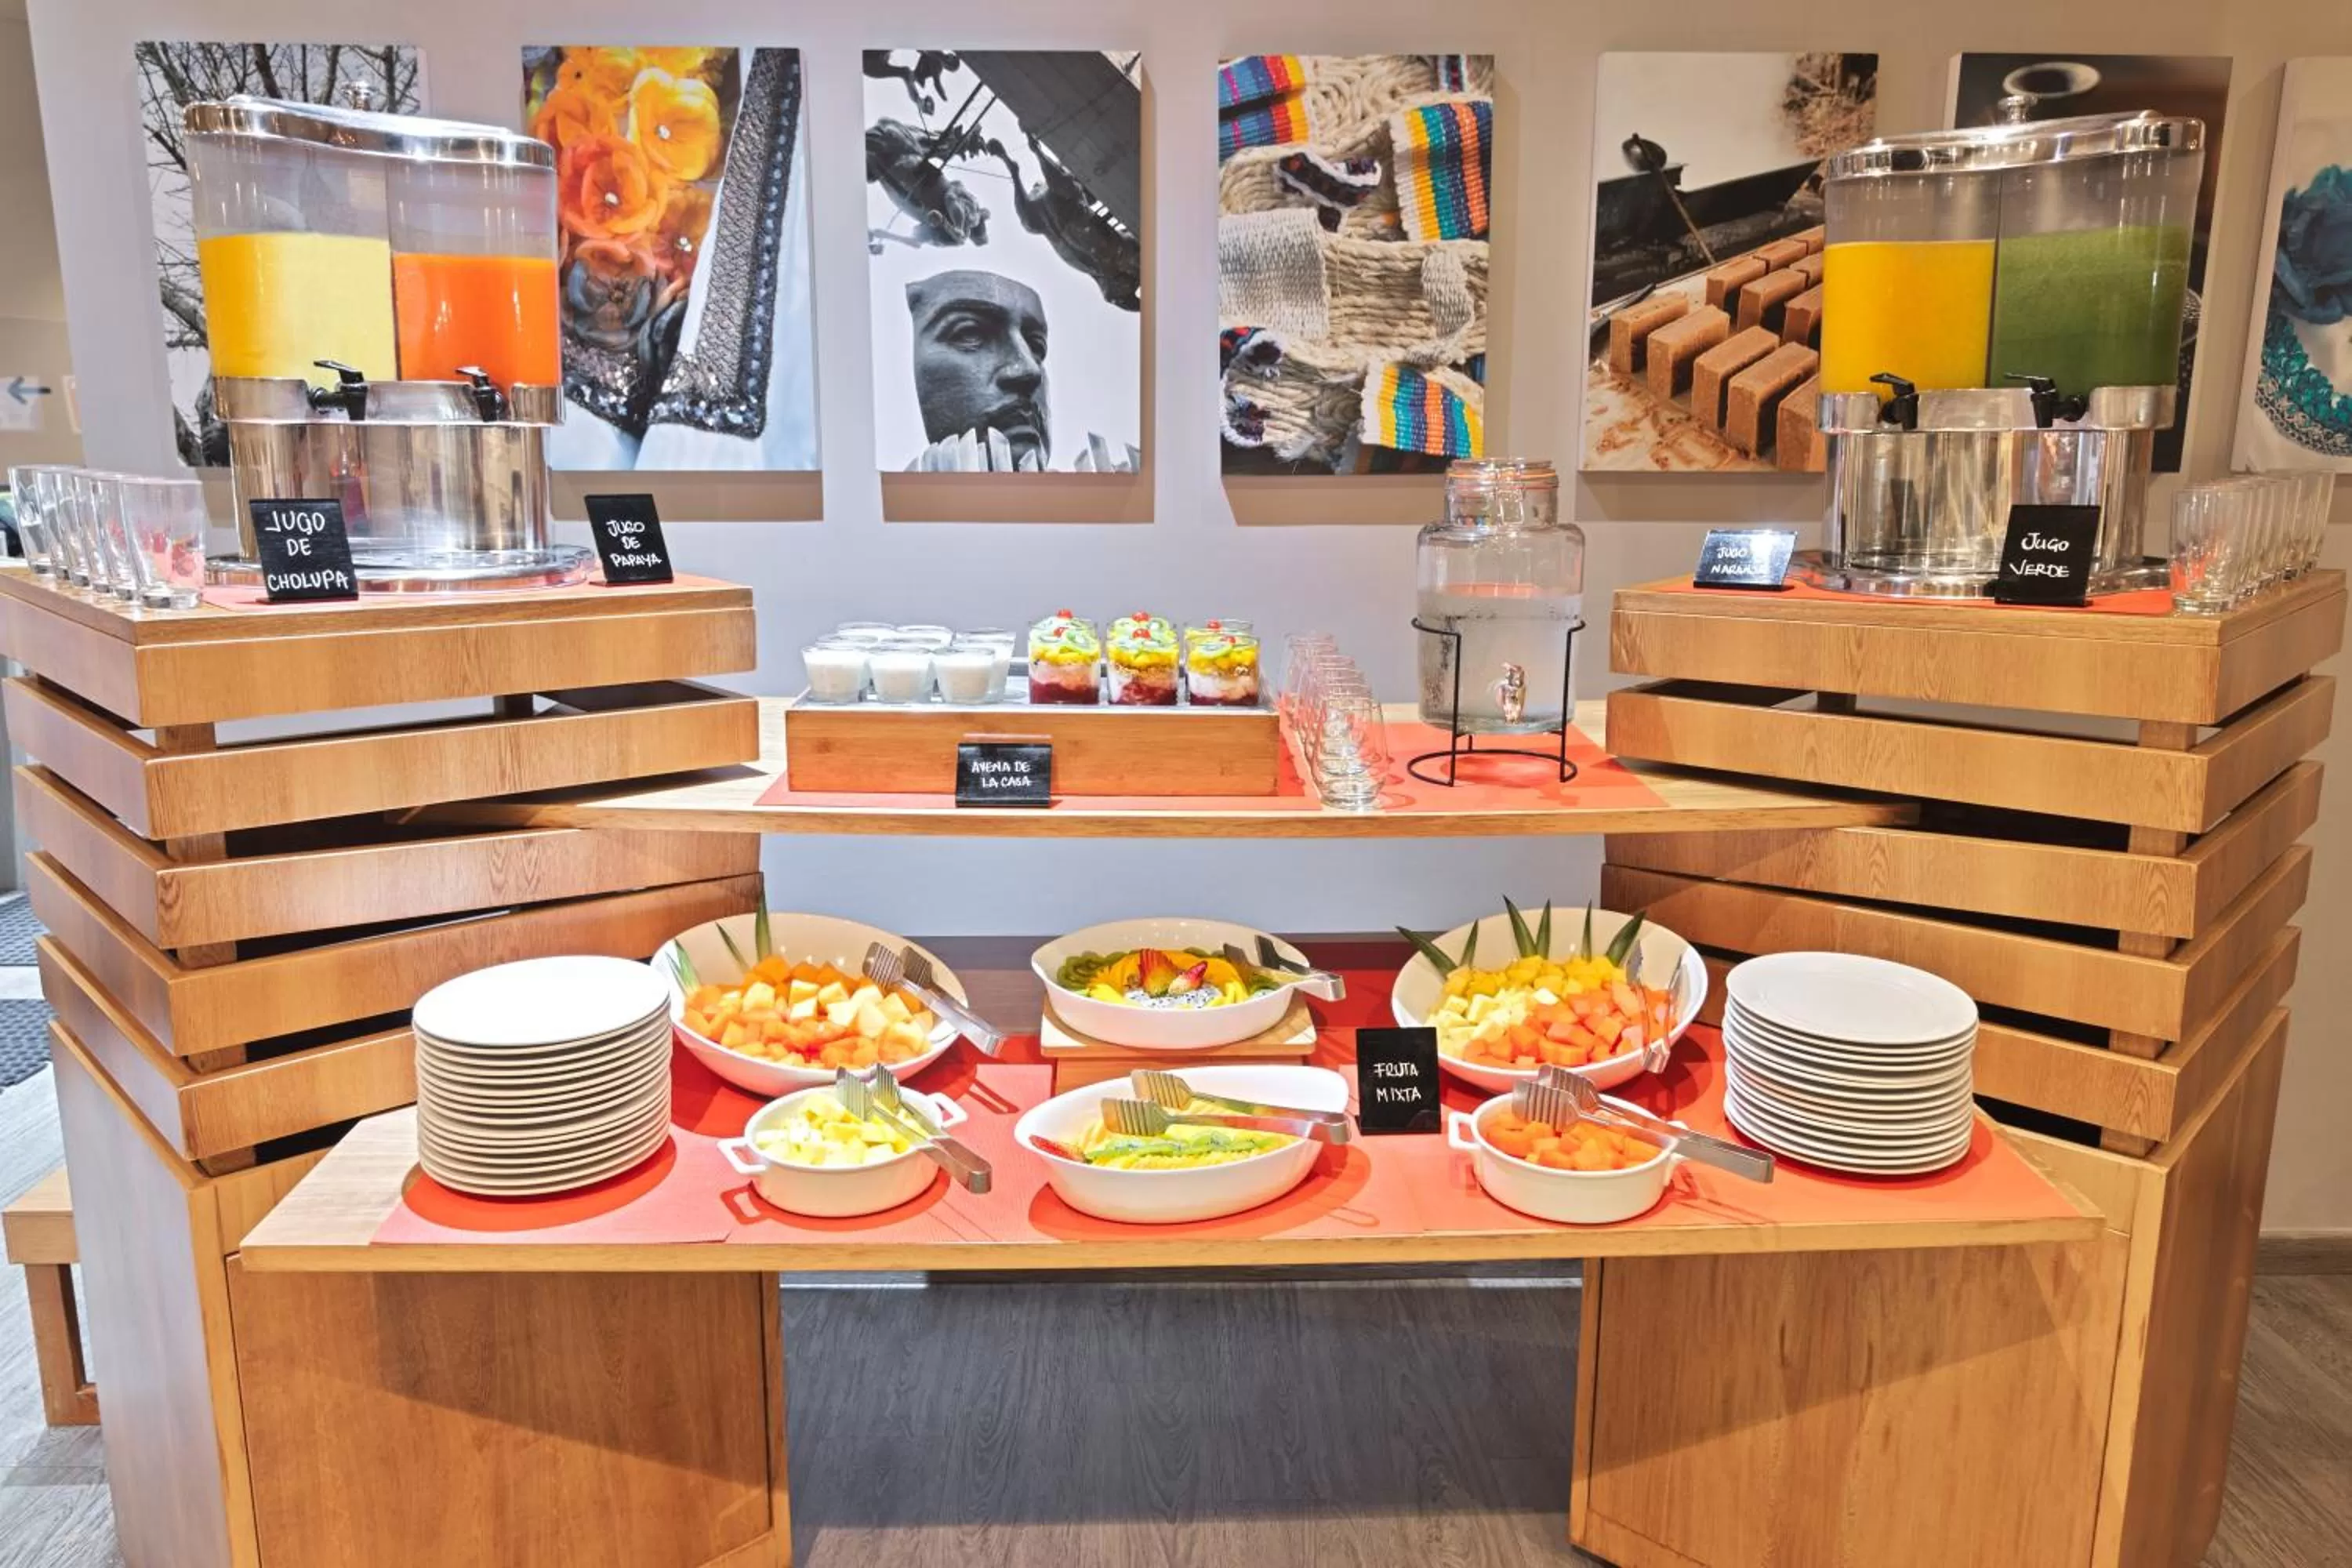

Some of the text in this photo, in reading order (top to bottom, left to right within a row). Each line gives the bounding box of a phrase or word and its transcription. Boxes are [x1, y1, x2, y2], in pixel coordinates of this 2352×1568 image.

[264, 510, 325, 535] JUGO
[606, 519, 645, 537] JUGO
[286, 538, 311, 557] DE
[621, 535, 641, 550] DE
[610, 553, 662, 568] PAPAYA
[2009, 559, 2071, 579] VERDE
[267, 568, 349, 592] CHOLUPA
[971, 760, 1031, 773] AVENA DE
[982, 775, 1032, 788] LA CASA
[1373, 1062, 1419, 1078] FRUTA
[1376, 1086, 1422, 1103] MIXTA
